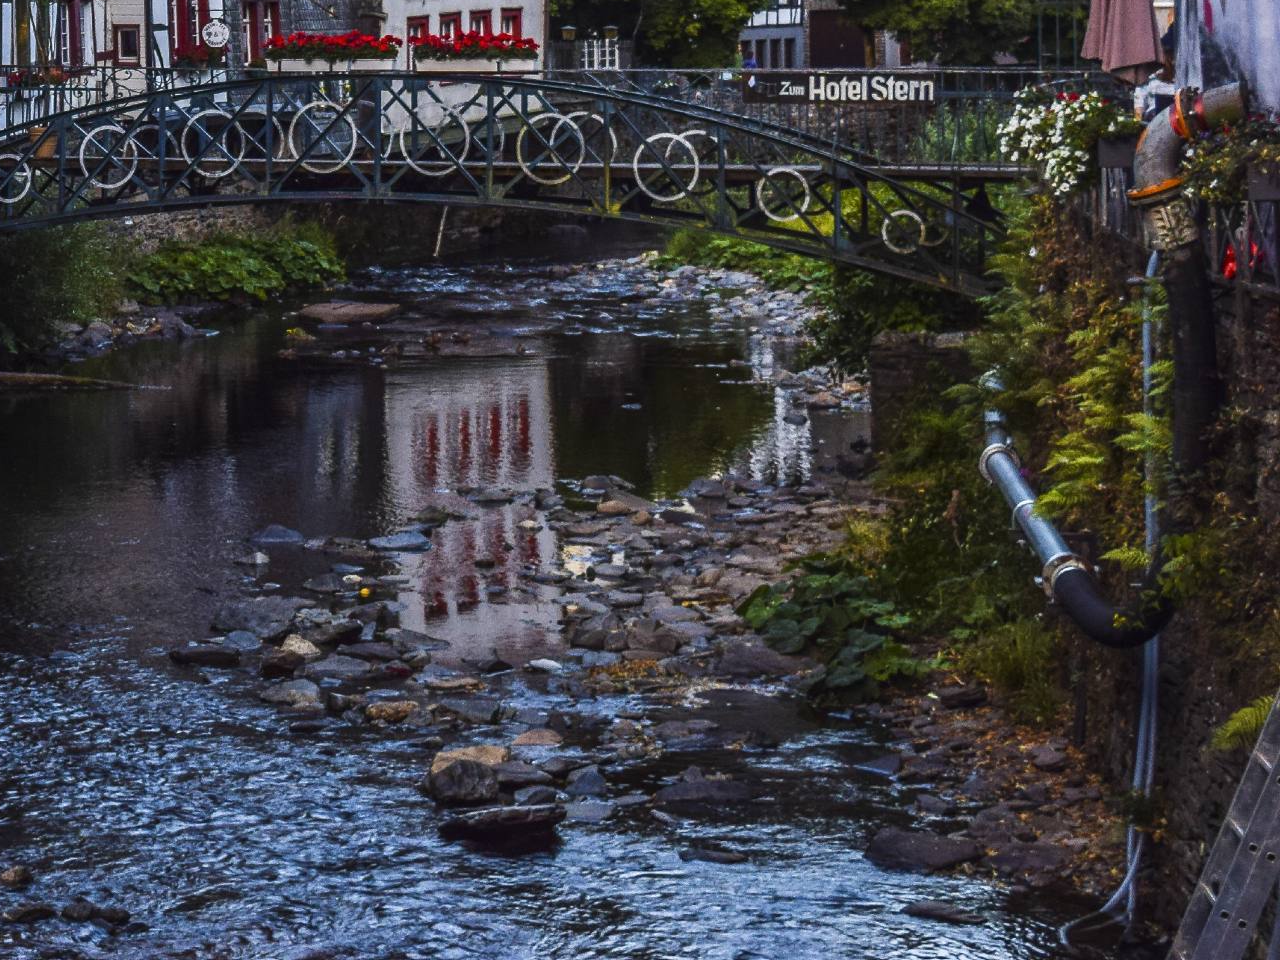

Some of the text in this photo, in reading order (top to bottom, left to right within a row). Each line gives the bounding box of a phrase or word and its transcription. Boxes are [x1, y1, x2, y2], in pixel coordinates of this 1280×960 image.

[779, 75, 934, 101] Zum Hotel Stern
